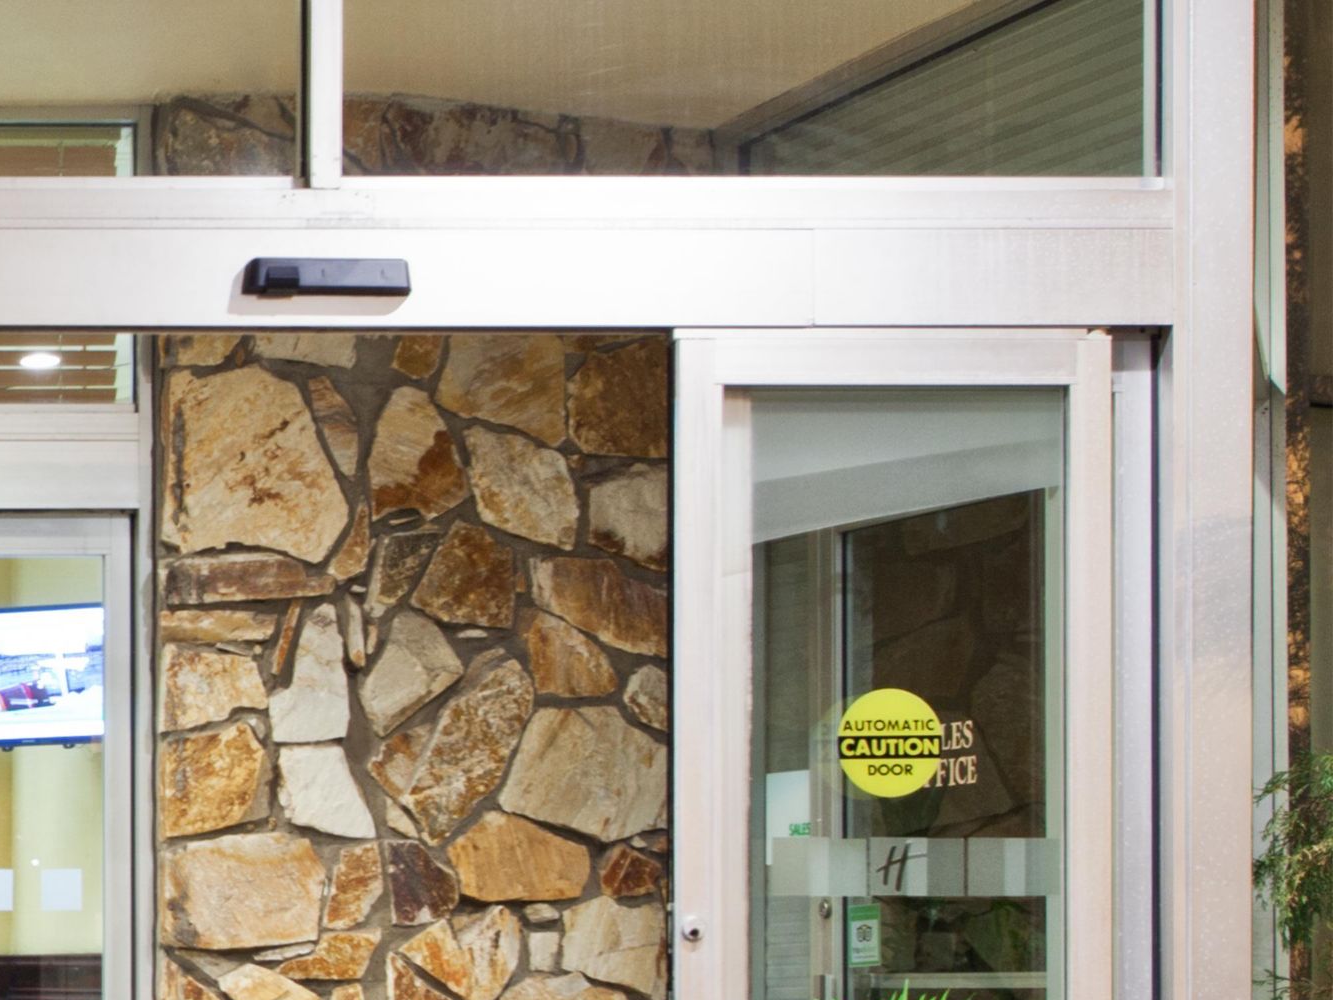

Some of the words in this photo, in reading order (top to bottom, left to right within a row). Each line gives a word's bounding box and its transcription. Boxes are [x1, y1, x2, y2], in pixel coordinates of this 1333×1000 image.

[843, 719, 934, 731] AUTOMATIC
[840, 738, 940, 756] CAUTION
[868, 764, 913, 776] DOOR
[923, 755, 978, 788] FICE
